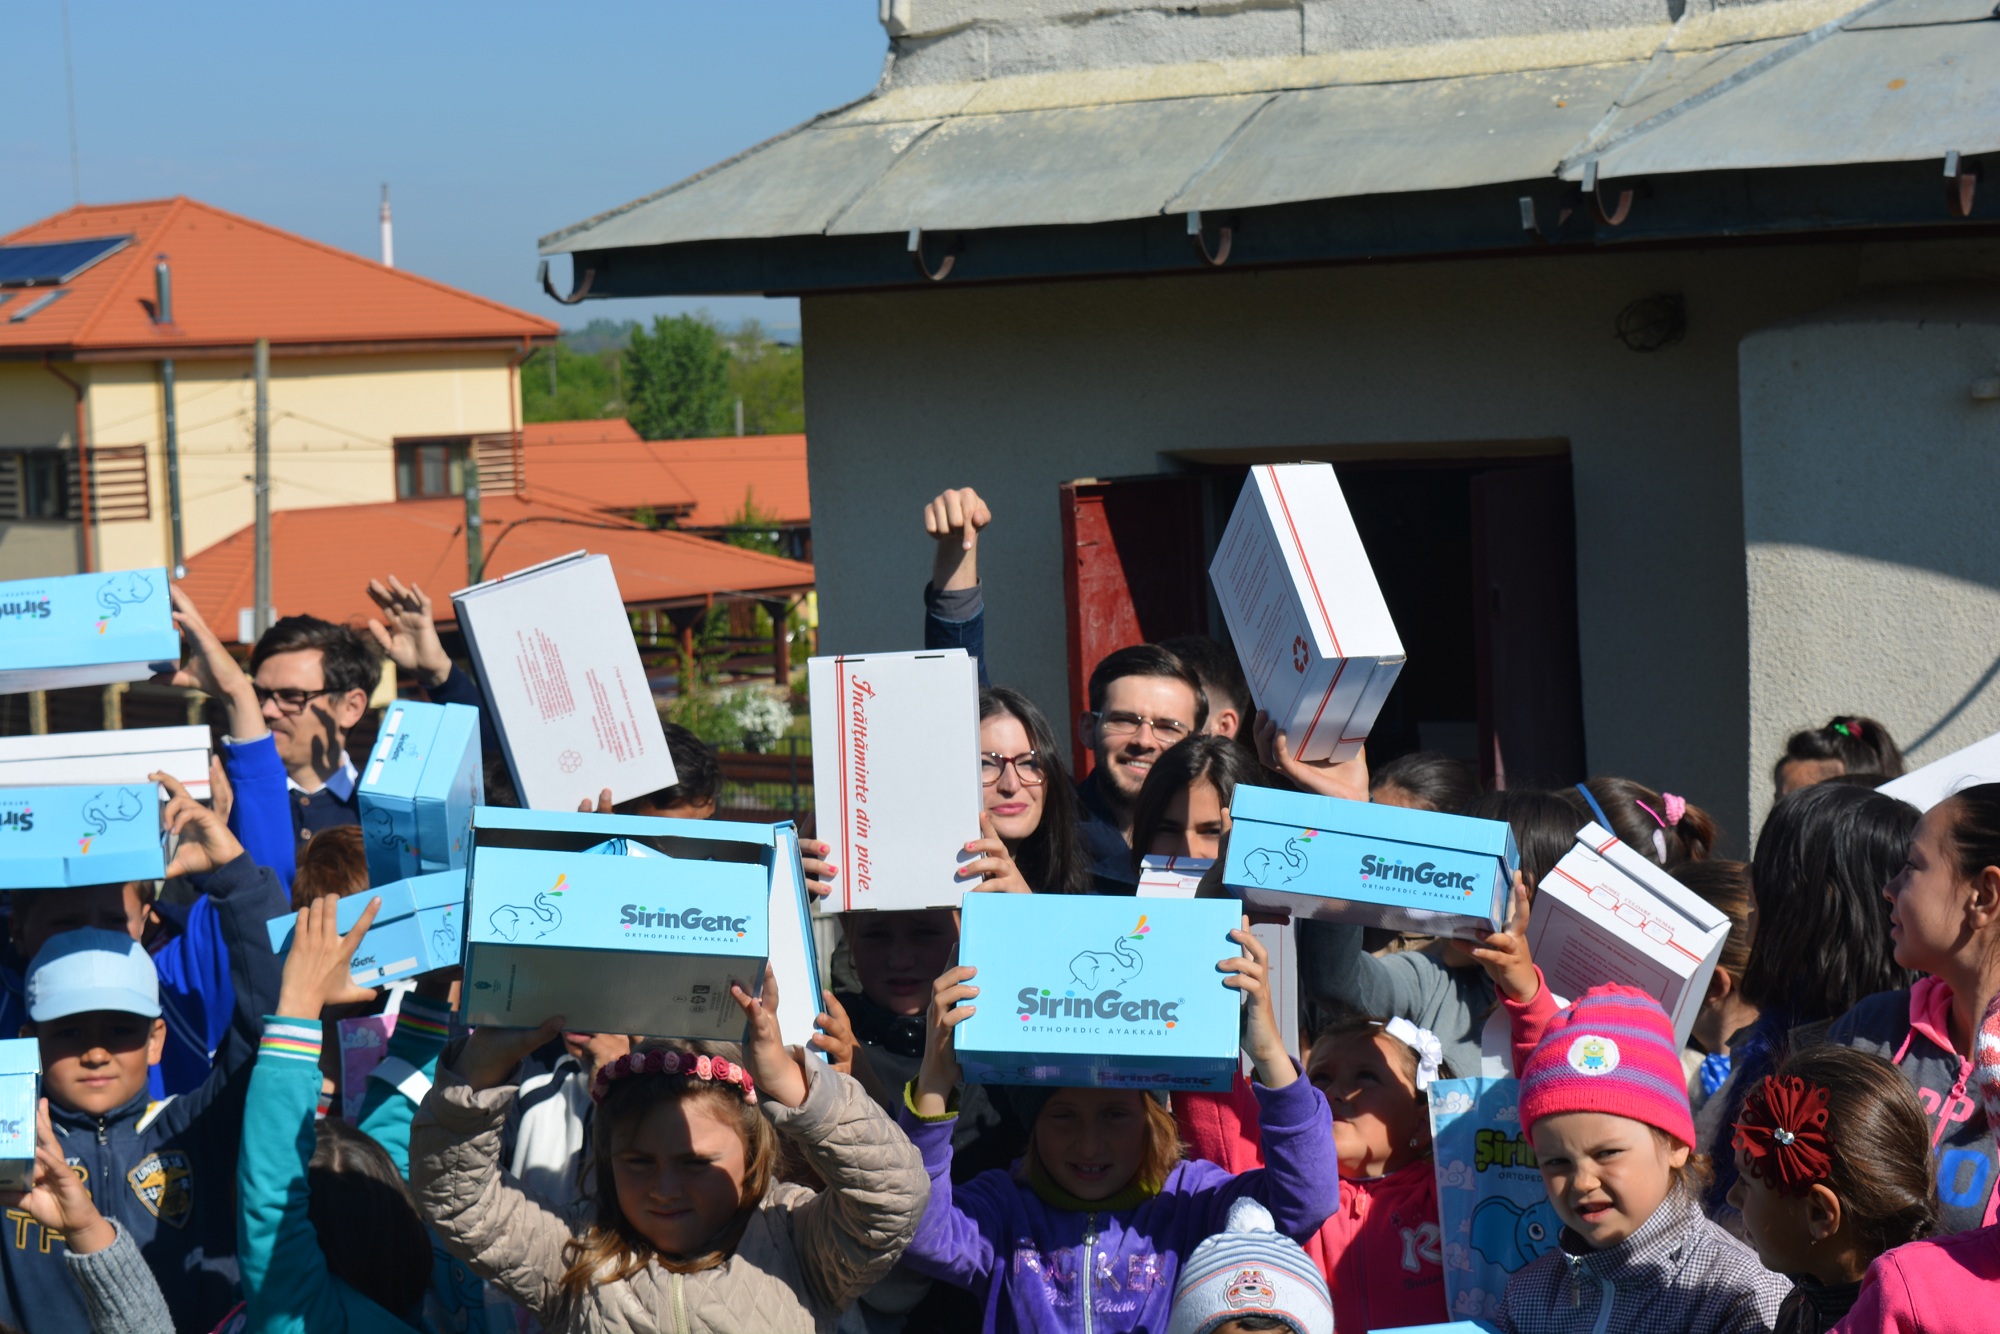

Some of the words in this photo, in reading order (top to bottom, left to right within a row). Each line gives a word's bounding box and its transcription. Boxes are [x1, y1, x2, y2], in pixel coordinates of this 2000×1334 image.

[856, 807, 871, 839] din
[855, 843, 872, 893] piele.
[1361, 882, 1417, 895] ORTHOPEDIC
[1422, 891, 1465, 901] AYAKKABI
[625, 932, 686, 941] ORTHOPEDIC
[1022, 1025, 1100, 1034] ORTHOPEDIC
[1108, 1028, 1168, 1036] AYAKKABI
